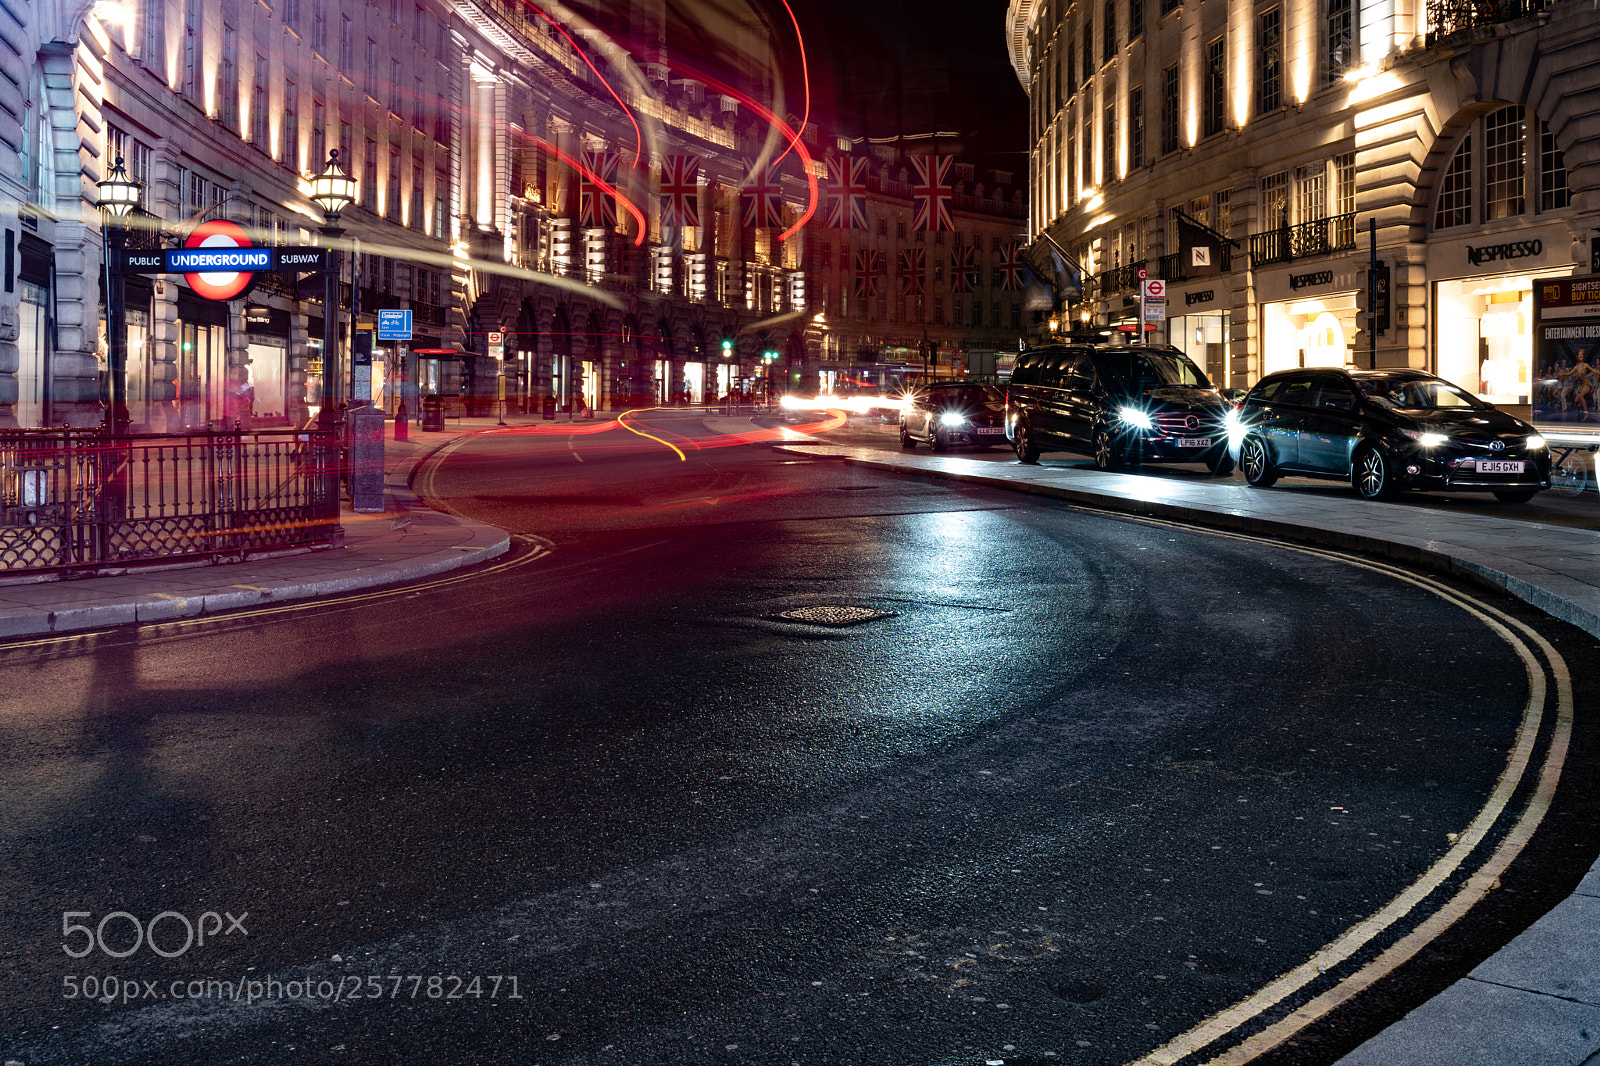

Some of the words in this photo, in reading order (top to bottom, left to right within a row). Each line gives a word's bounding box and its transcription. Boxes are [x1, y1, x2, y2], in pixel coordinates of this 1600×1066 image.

[1465, 238, 1543, 267] NESPRESSO
[129, 256, 161, 267] PUBLIC
[171, 254, 268, 266] UNDERGROUND
[280, 254, 320, 264] SUBWAY
[1138, 269, 1146, 279] G
[1288, 270, 1334, 292] NESPRESSO
[1184, 289, 1215, 307] NESPRESSO
[1572, 291, 1586, 300] BUY
[1545, 326, 1585, 340] ENTERTAINMENT
[1481, 462, 1501, 471] EJ15
[1502, 462, 1519, 471] GXH
